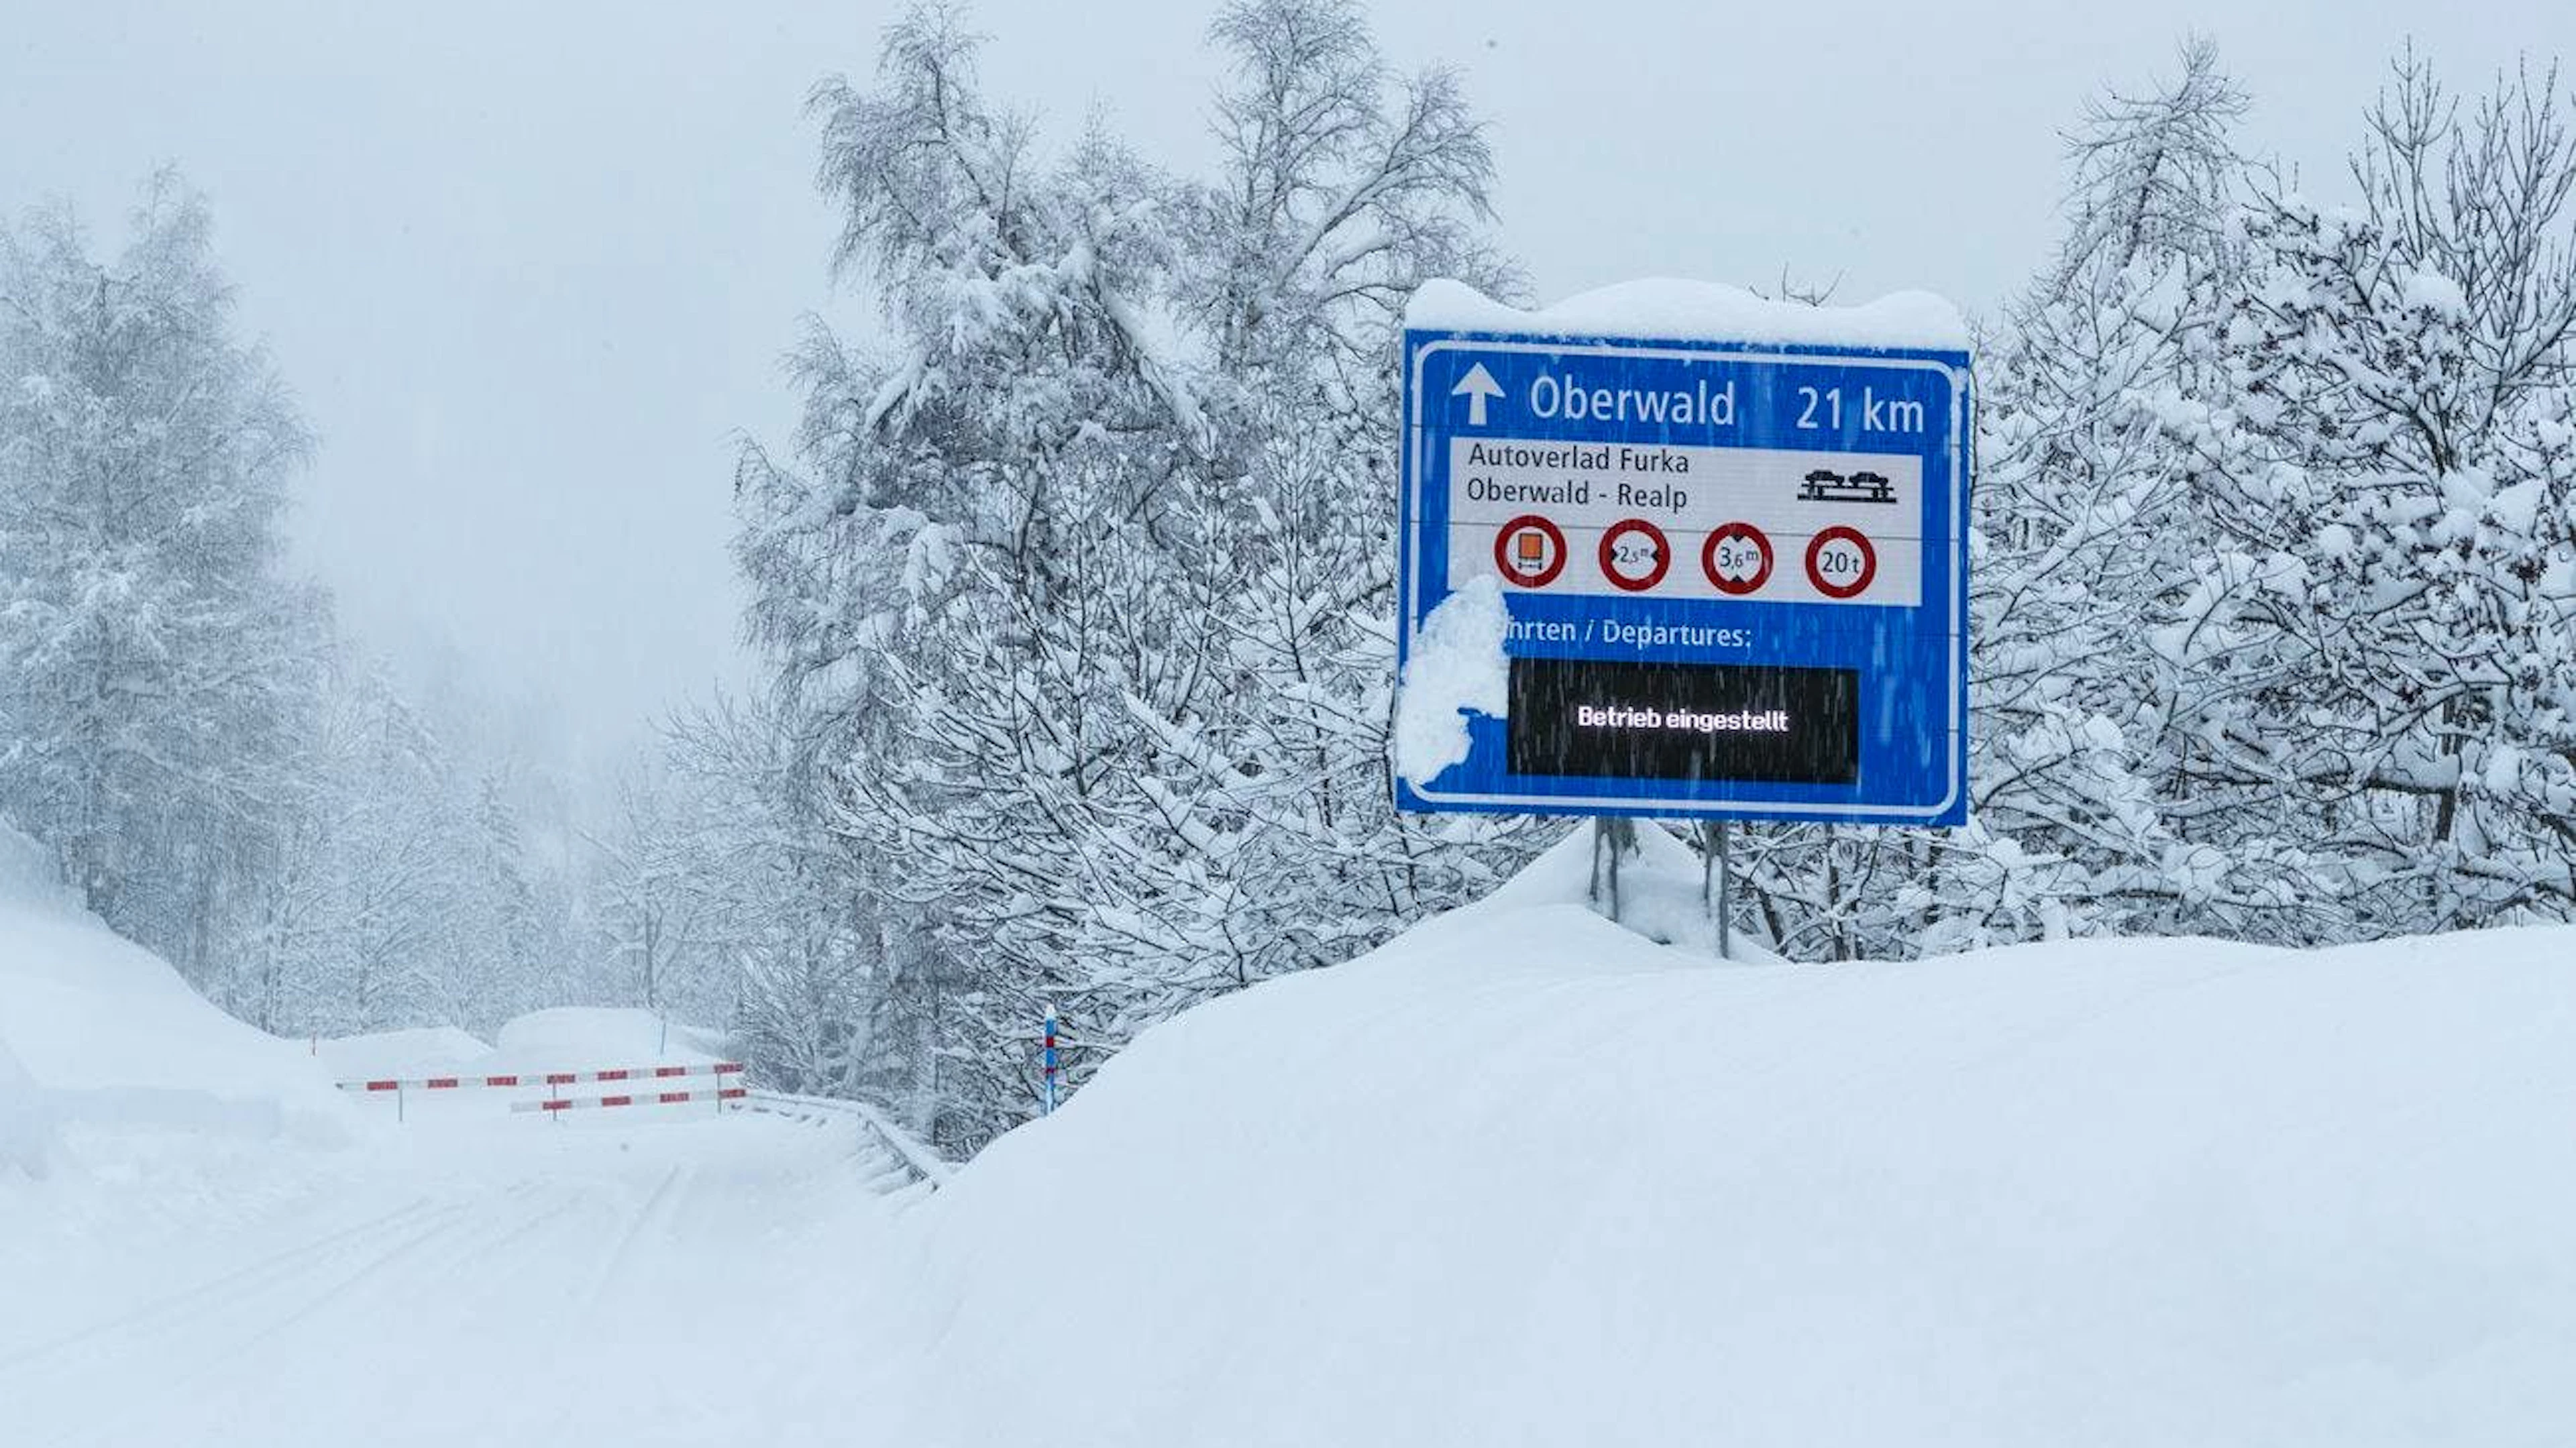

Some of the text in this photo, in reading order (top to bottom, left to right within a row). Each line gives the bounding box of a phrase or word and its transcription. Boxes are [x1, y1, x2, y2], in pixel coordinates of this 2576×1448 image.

[1530, 373, 1923, 433] Oberwald 21 km
[1468, 443, 1689, 474] Autoverlad Furka
[1467, 477, 1590, 504] Oberwald
[1618, 482, 1688, 514] Realp
[1508, 614, 1577, 642] hrten
[1584, 619, 1595, 642] /
[1578, 705, 1789, 732] Betrieb eingestellt
